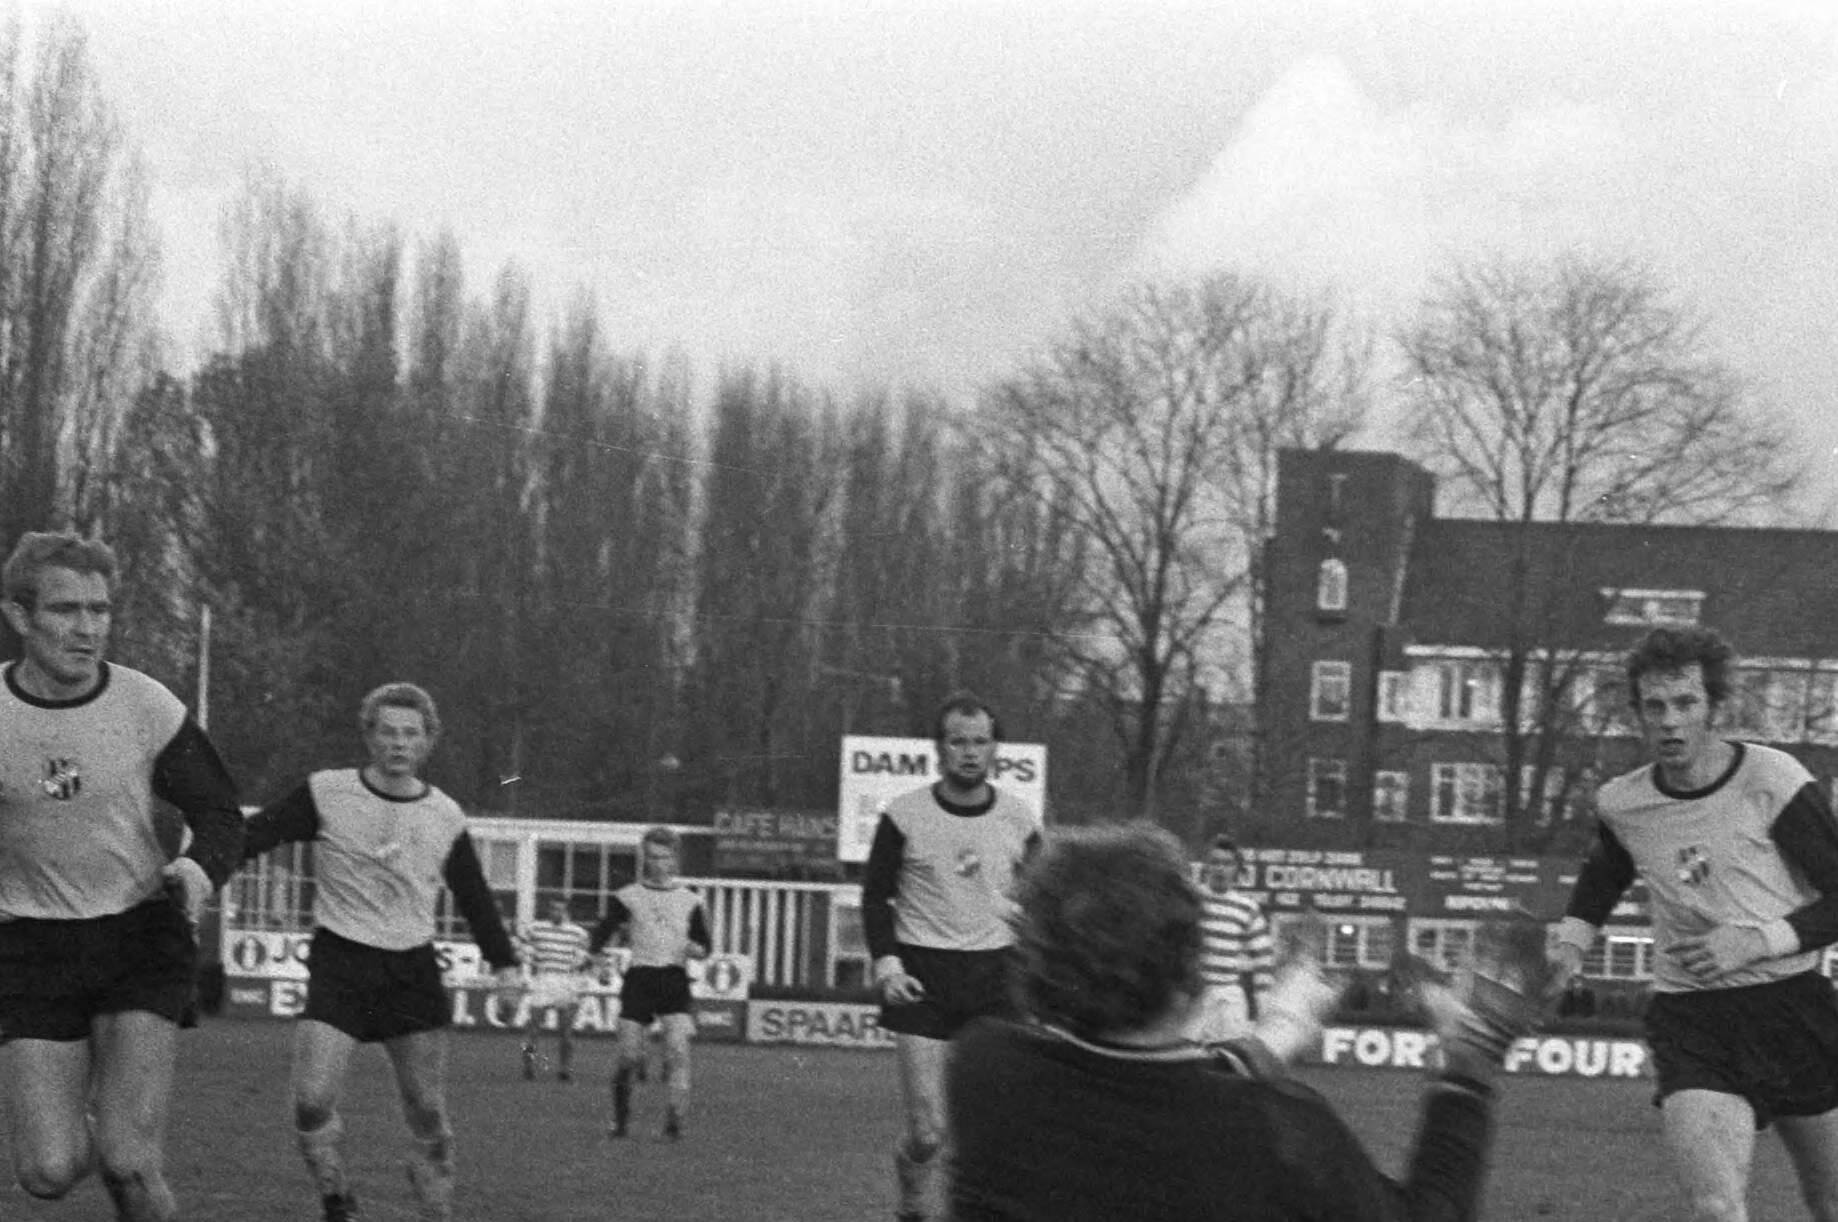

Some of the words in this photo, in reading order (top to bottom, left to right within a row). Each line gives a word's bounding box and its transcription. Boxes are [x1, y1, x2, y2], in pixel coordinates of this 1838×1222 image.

[851, 750, 930, 776] DAM
[996, 758, 1035, 783] PS
[1504, 1038, 1647, 1078] FOUR
